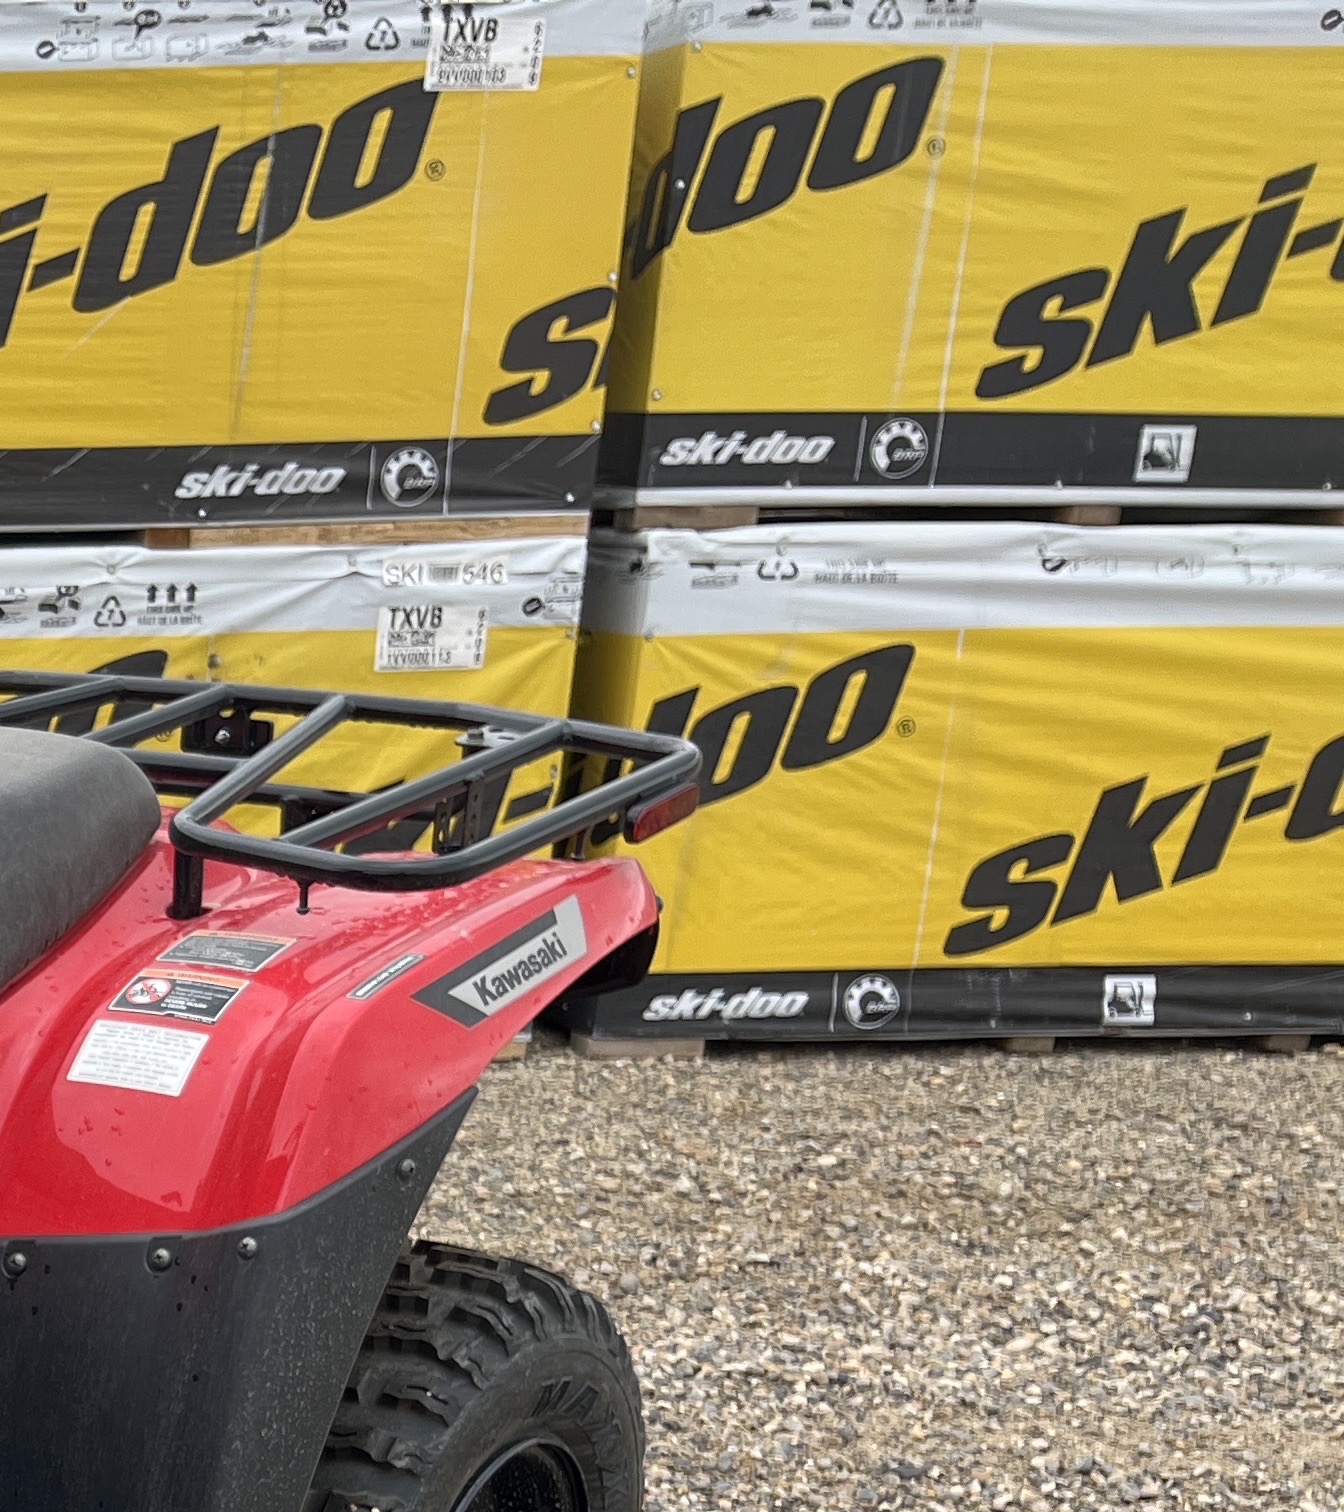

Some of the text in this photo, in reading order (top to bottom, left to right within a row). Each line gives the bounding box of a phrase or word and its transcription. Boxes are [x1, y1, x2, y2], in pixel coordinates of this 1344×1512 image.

[975, 163, 1344, 399] ski-
[482, 287, 617, 426] s
[660, 430, 836, 466] ski-doo
[175, 461, 348, 499] ski-doo
[385, 562, 423, 585] SKI
[388, 606, 443, 630] TXVB
[472, 932, 569, 1007] Kawasaki
[642, 986, 810, 1021] ski-doo
